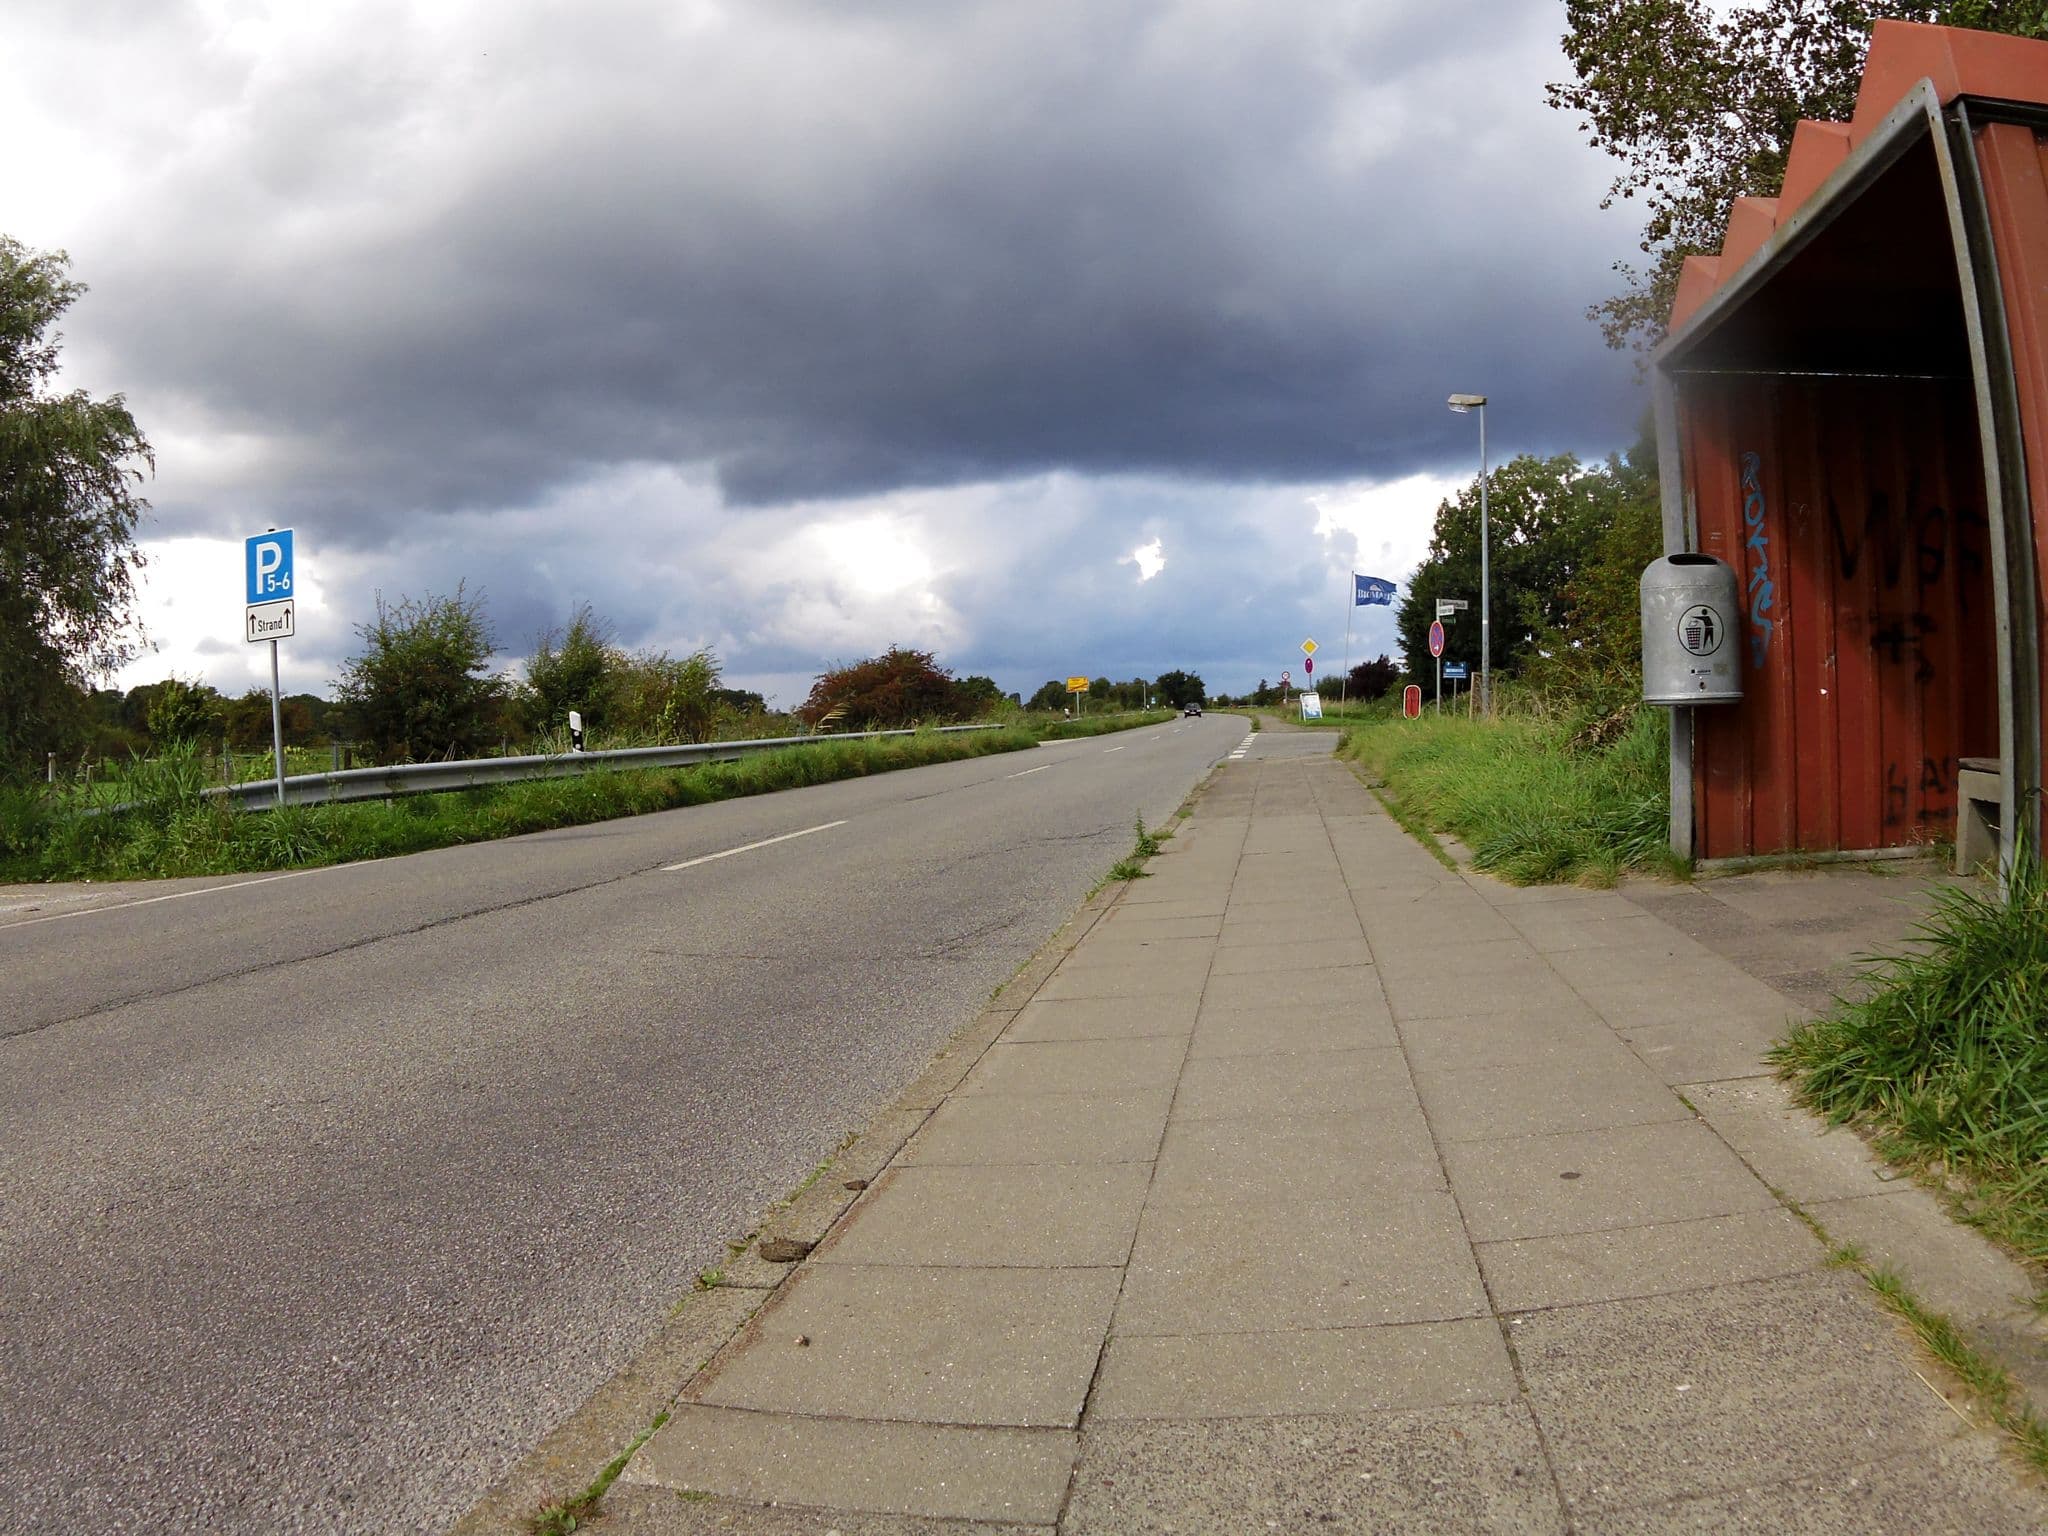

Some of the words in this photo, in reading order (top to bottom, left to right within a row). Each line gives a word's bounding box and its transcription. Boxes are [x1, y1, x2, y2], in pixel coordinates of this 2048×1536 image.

[256, 541, 282, 594] P
[267, 572, 290, 592] 5-6
[258, 616, 282, 632] Strand
